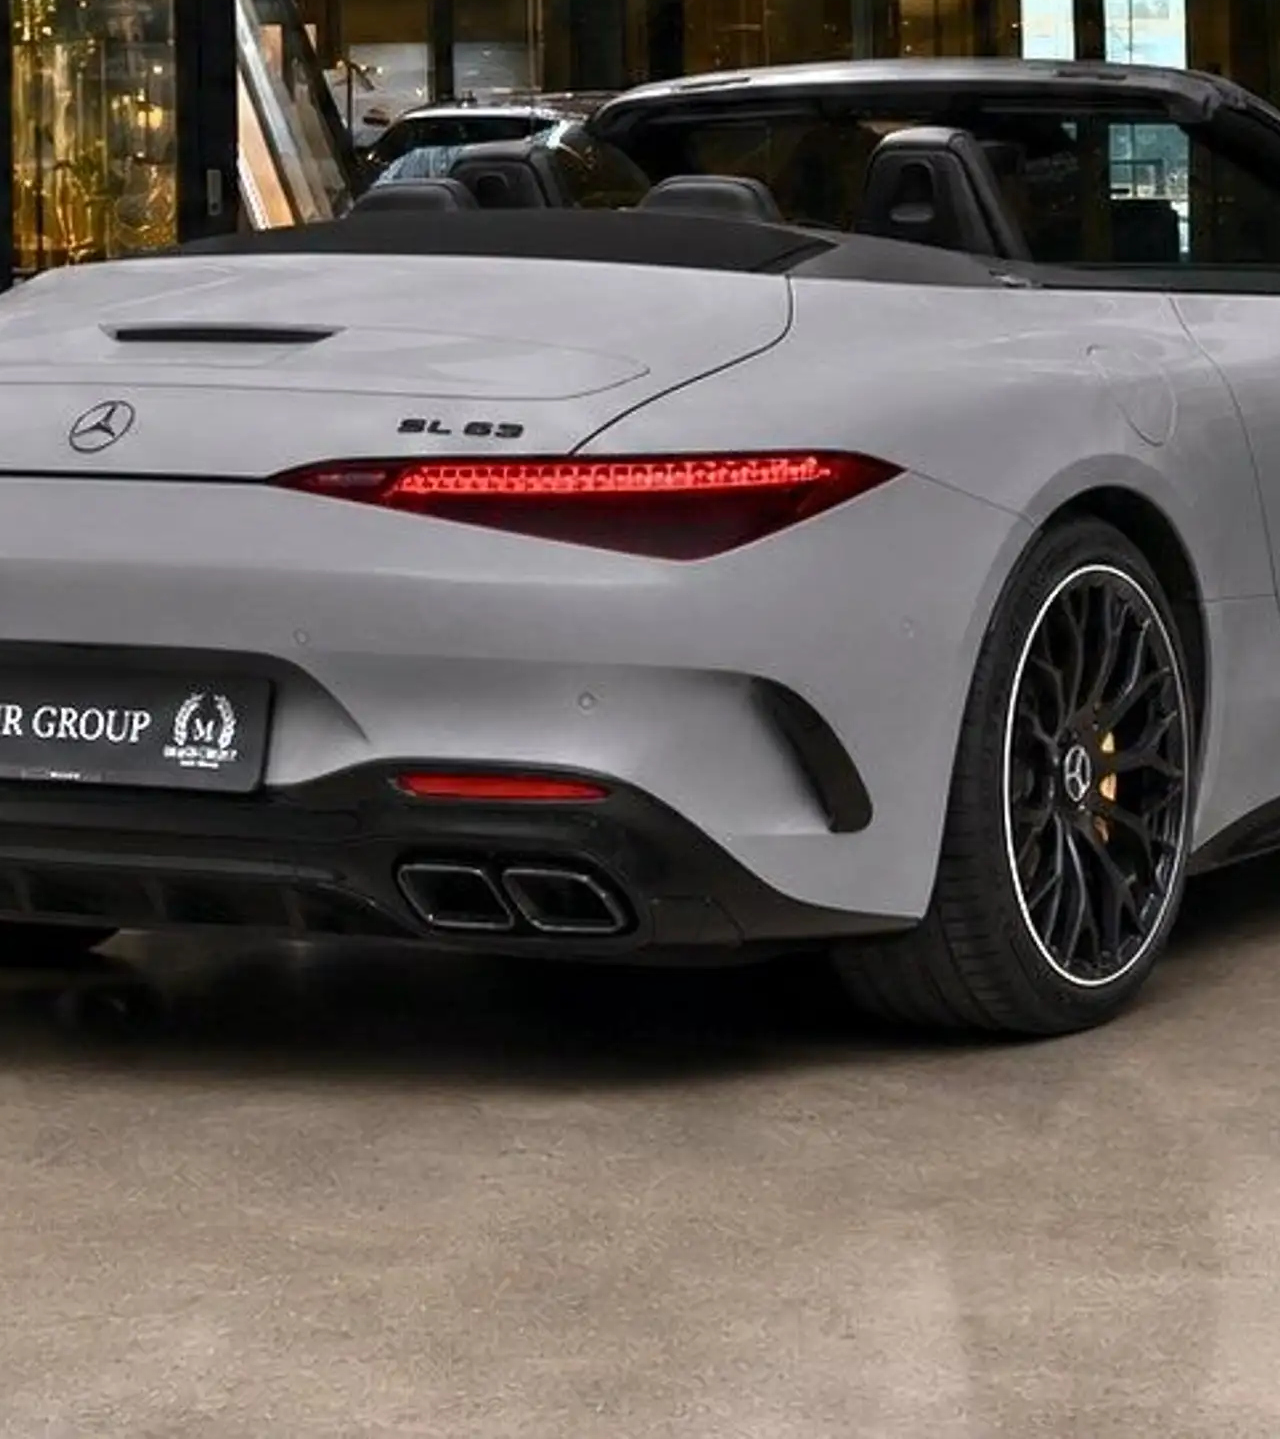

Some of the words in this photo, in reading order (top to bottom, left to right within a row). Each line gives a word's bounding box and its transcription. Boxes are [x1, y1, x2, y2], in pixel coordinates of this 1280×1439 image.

[397, 418, 452, 435] SL
[463, 421, 524, 439] 63
[32, 706, 151, 743] GROUP
